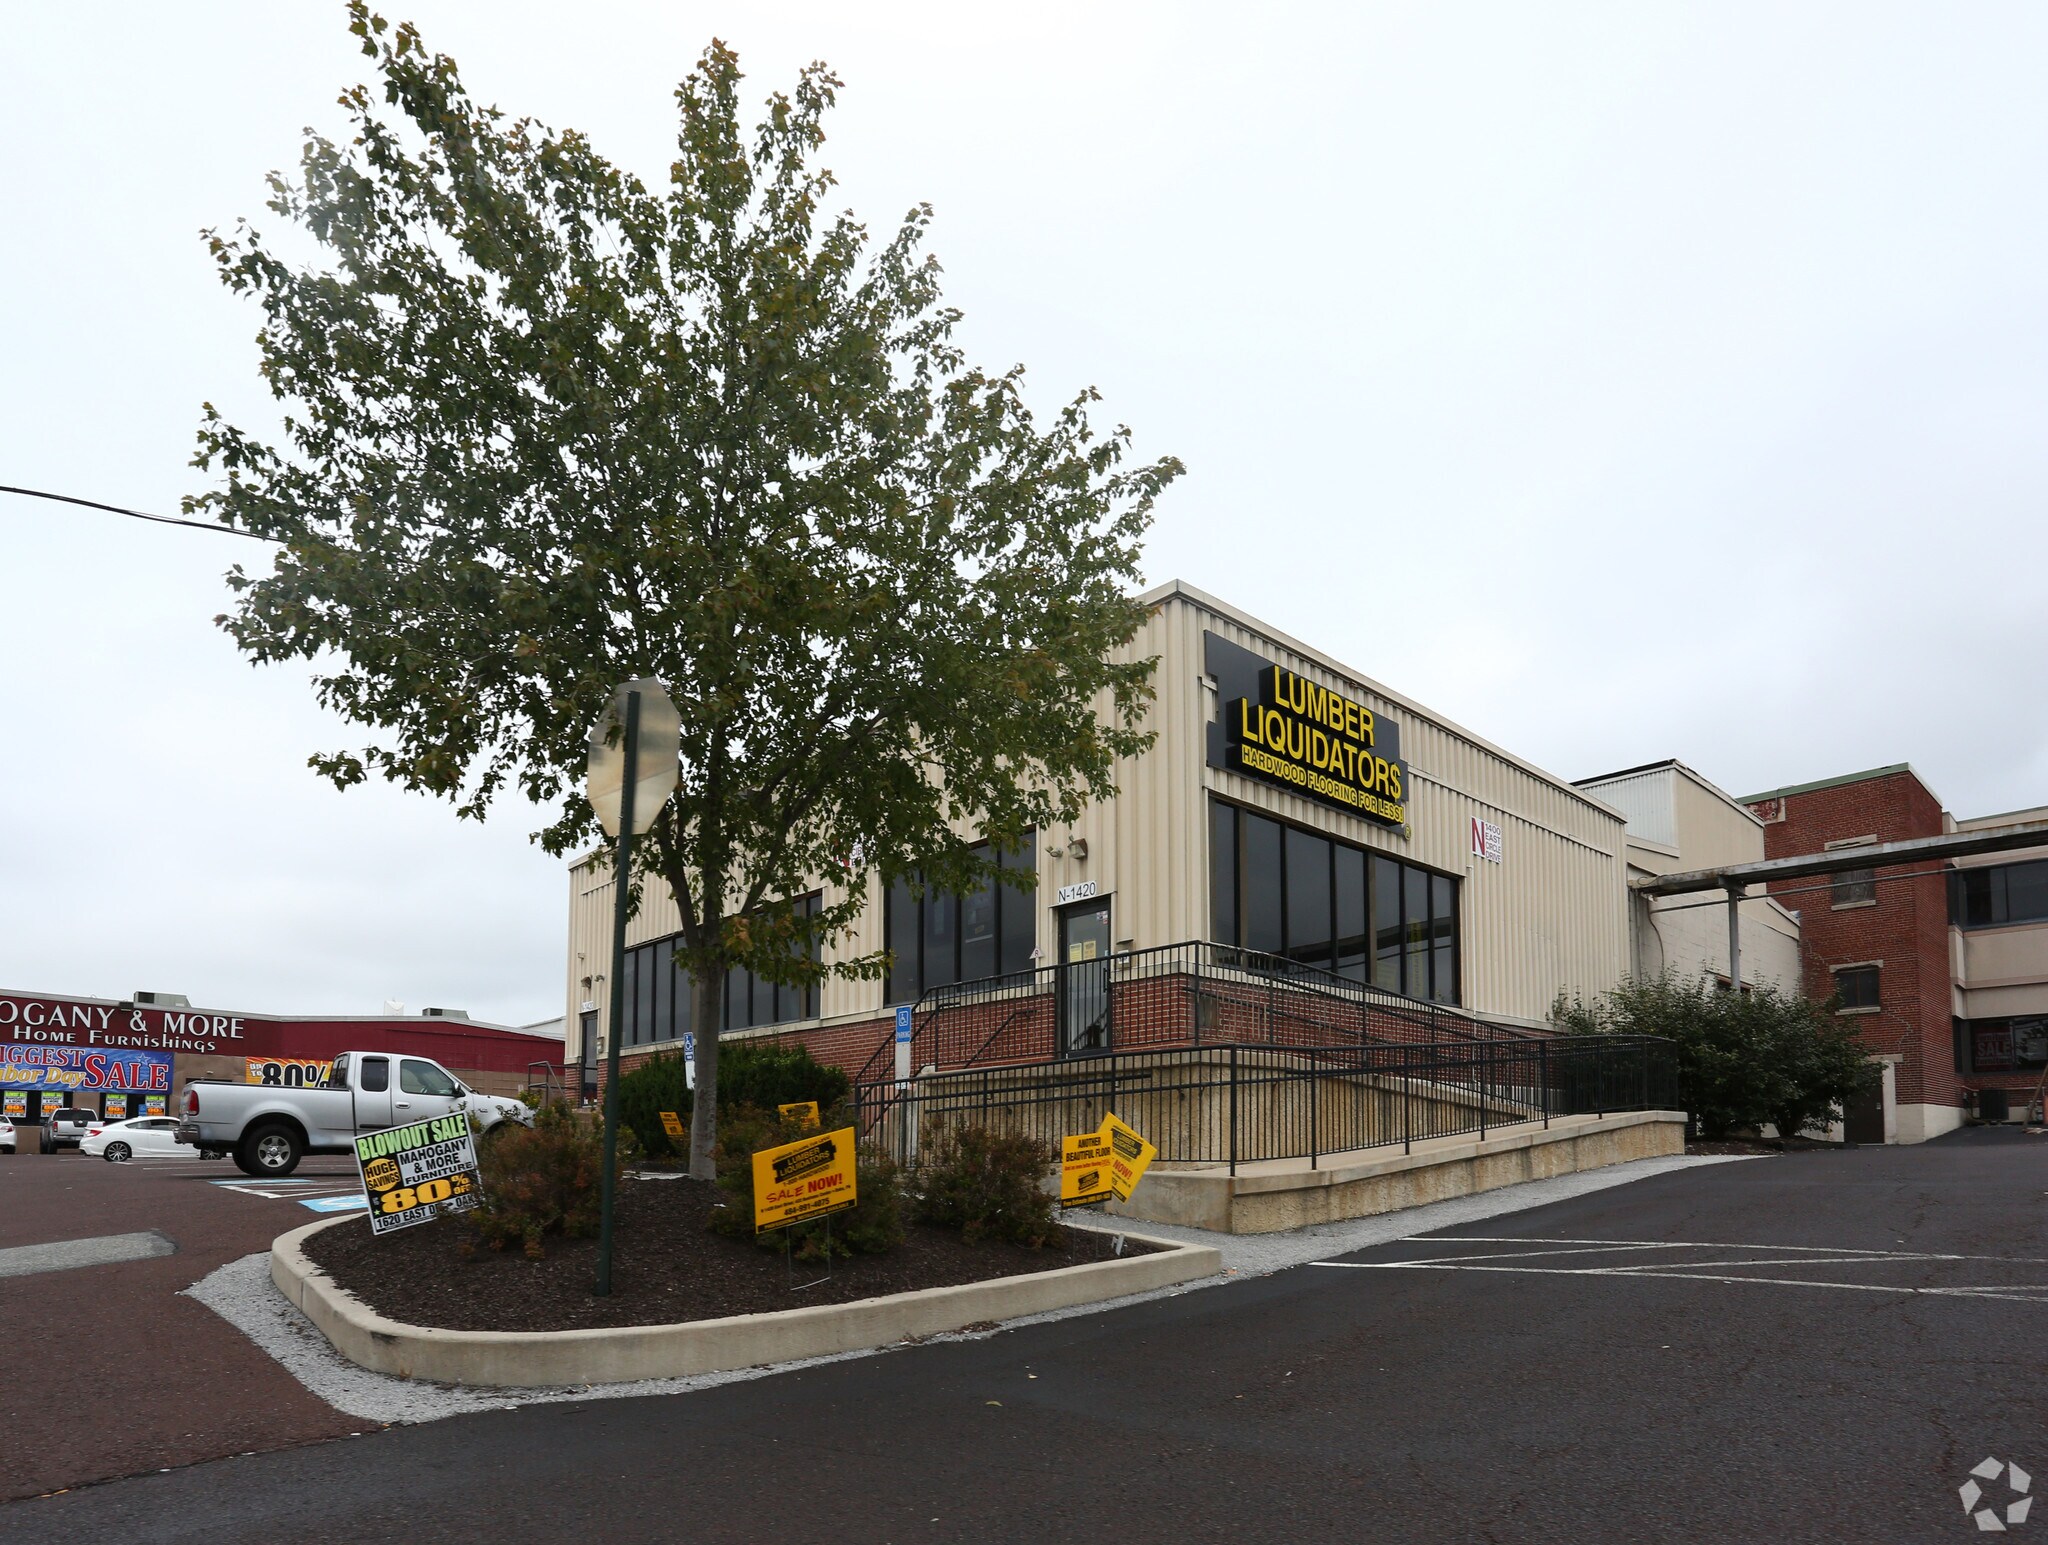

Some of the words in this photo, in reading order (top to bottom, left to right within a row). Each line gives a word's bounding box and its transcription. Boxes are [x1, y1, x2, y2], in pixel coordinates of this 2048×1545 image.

[1274, 665, 1375, 746] LUMBER
[1242, 744, 1306, 786] HARDWOOD
[1307, 771, 1357, 805] FLOORING
[1358, 790, 1378, 814] FOR
[1378, 799, 1404, 823] LESS!
[1472, 817, 1485, 856] N
[1485, 823, 1501, 836] 1400
[1485, 832, 1501, 844] EAST
[1058, 882, 1096, 902] N-1420
[0, 1000, 115, 1029] OGANY
[129, 1009, 148, 1032] &
[163, 1012, 245, 1039] MORE
[1977, 1042, 2012, 1057] SALE
[44, 1067, 86, 1088] Day
[83, 1054, 168, 1091] SALE
[357, 1123, 429, 1161] BLOWOUT
[430, 1114, 467, 1142] SALE
[1078, 1136, 1101, 1148] ANOTHER
[399, 1138, 467, 1166] MAHOGANY
[787, 1147, 820, 1165] LUMBER
[1066, 1149, 1094, 1162] BEAUTIFUL
[1096, 1147, 1111, 1158] FLOOR
[365, 1160, 396, 1179] HUGE
[405, 1161, 473, 1186] FURNITURE
[414, 1162, 423, 1175] &
[426, 1152, 461, 1172] MORE
[1112, 1160, 1133, 1180] NOW!
[367, 1171, 401, 1190] SAVINGS
[766, 1185, 804, 1203] SALE
[807, 1173, 843, 1193] NOW!
[376, 1214, 401, 1228] 1620
[403, 1207, 426, 1220] EAST
